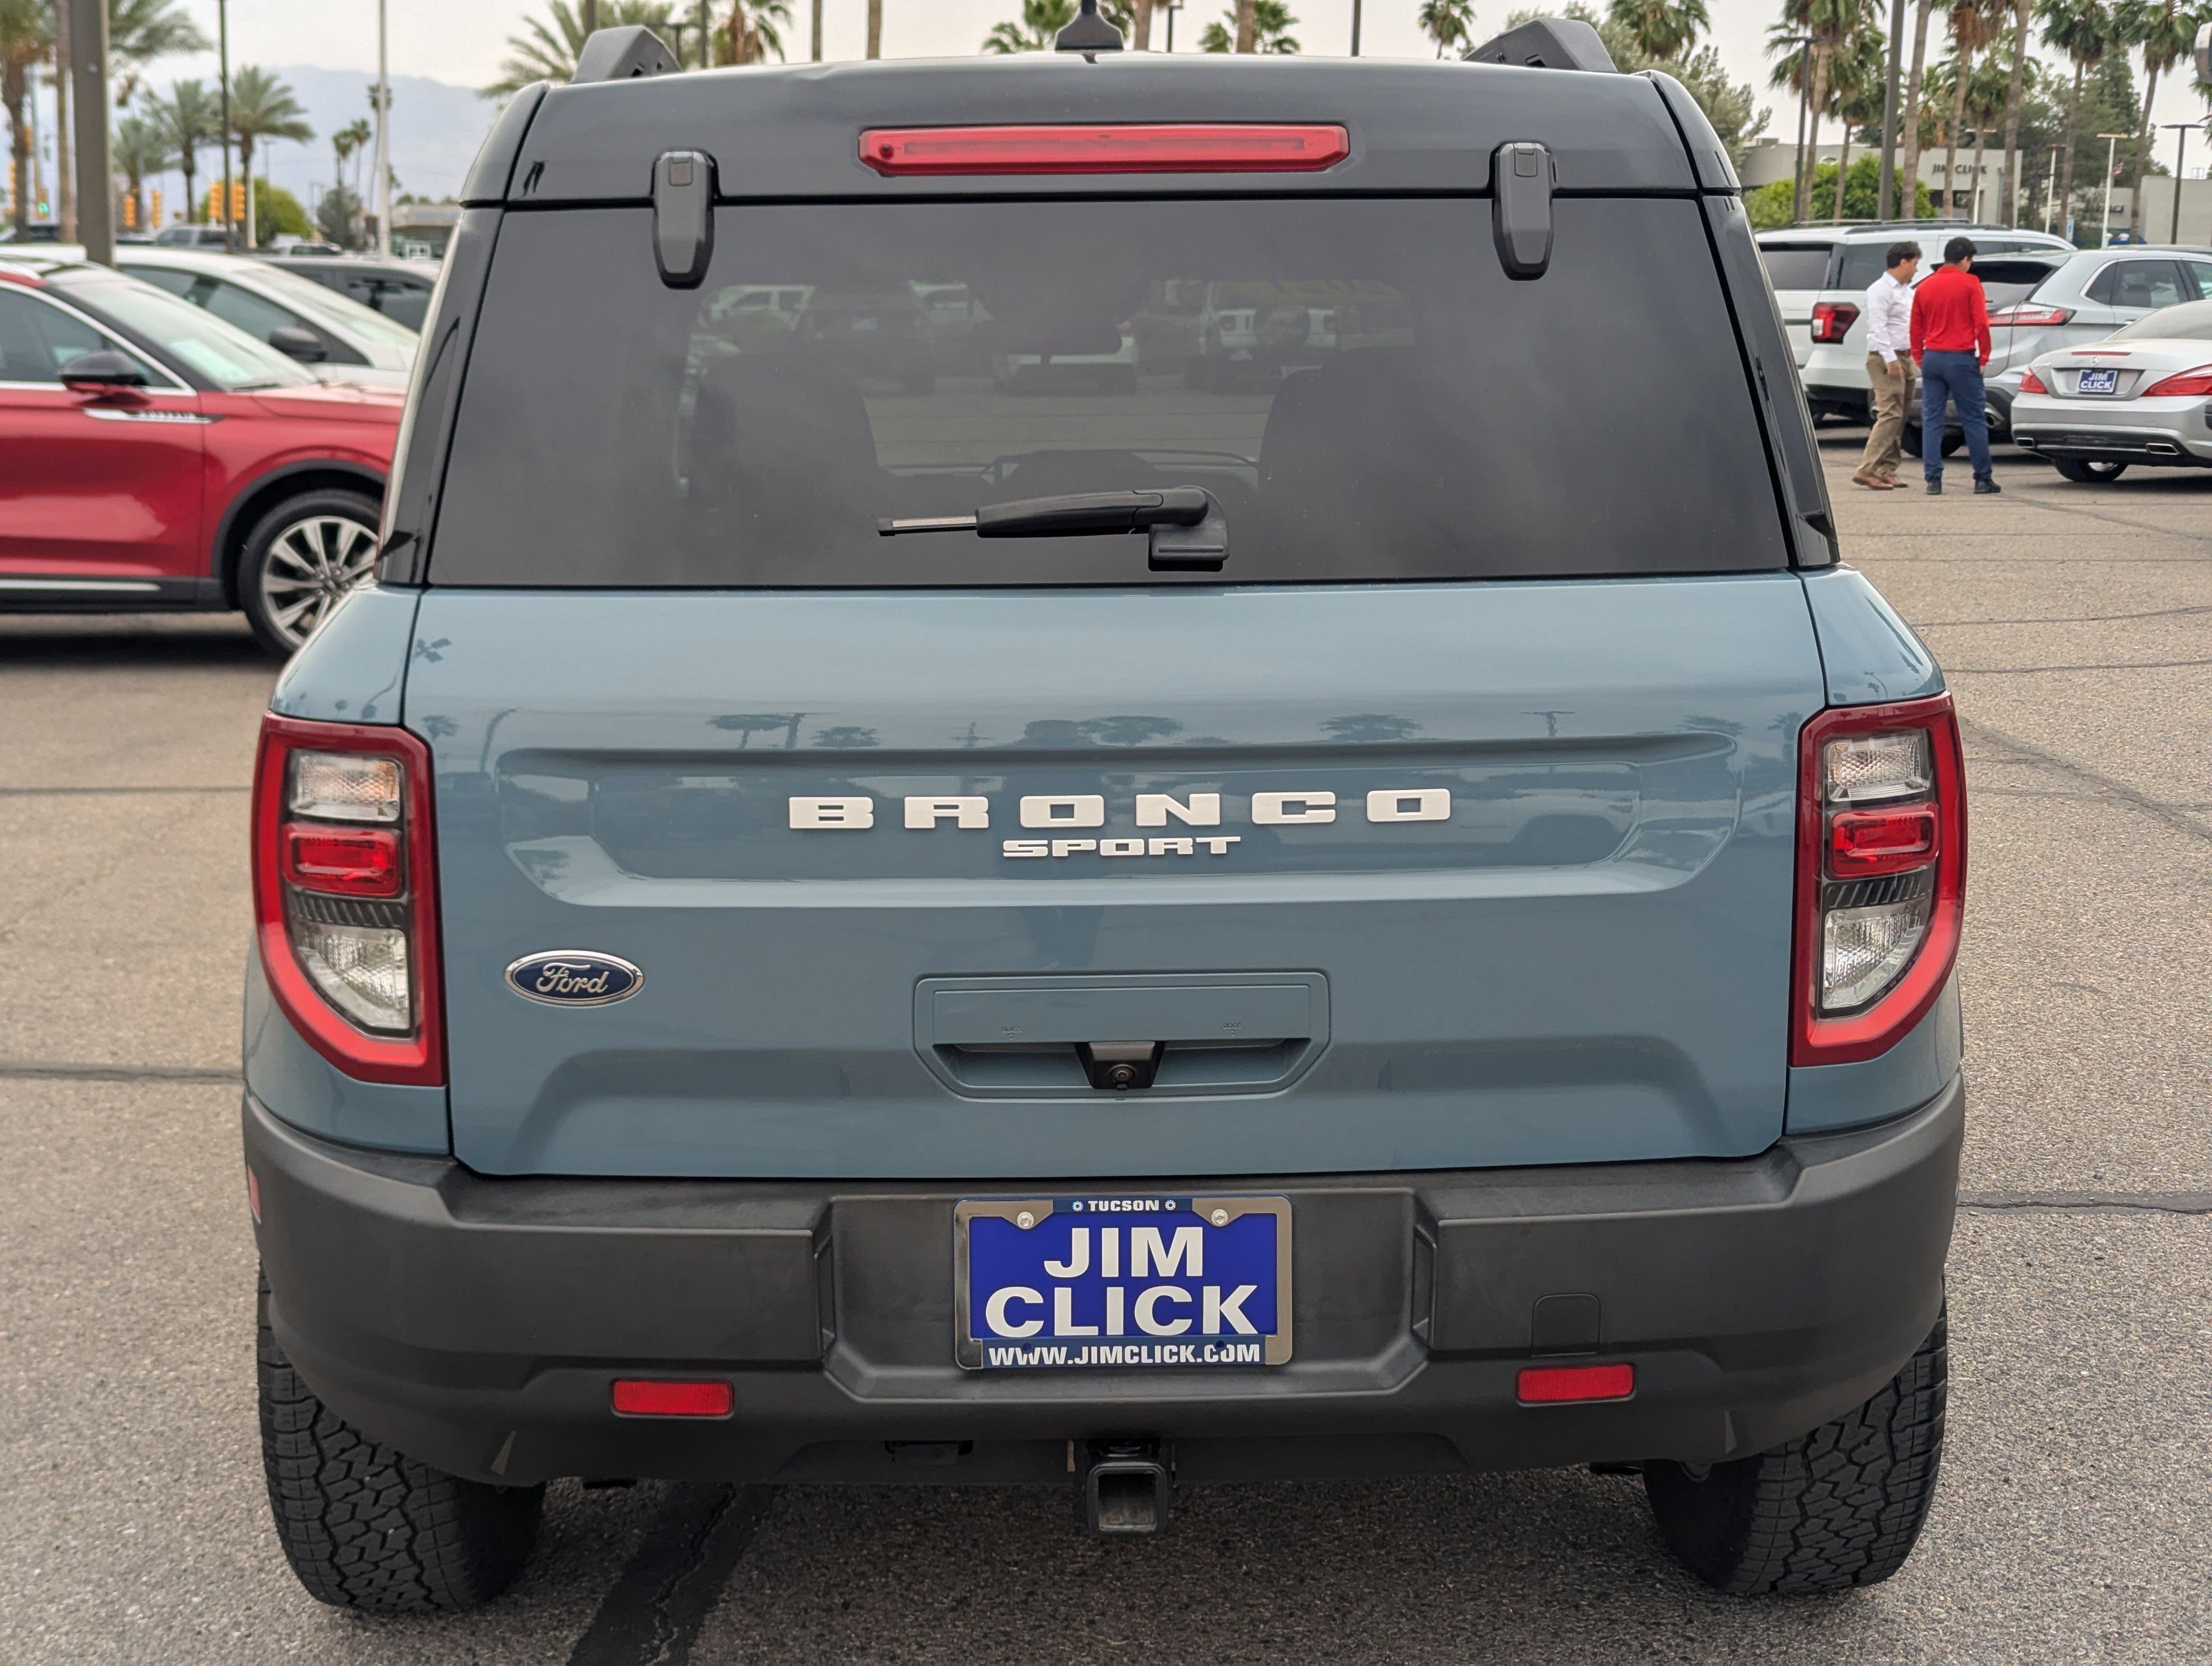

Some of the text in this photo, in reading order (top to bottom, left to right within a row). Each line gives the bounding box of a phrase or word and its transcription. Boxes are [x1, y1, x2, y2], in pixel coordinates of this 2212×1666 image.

[1954, 164, 1988, 174] CLIK
[789, 789, 1451, 830] BRONCO
[1002, 836, 1242, 857] SPORT
[536, 962, 610, 994] Ford
[1088, 1200, 1160, 1212] TUCSON
[1043, 1226, 1204, 1278] JIM
[985, 1285, 1258, 1338] CLICK
[988, 1343, 1261, 1366] WWW.JIMCLICK.COM
